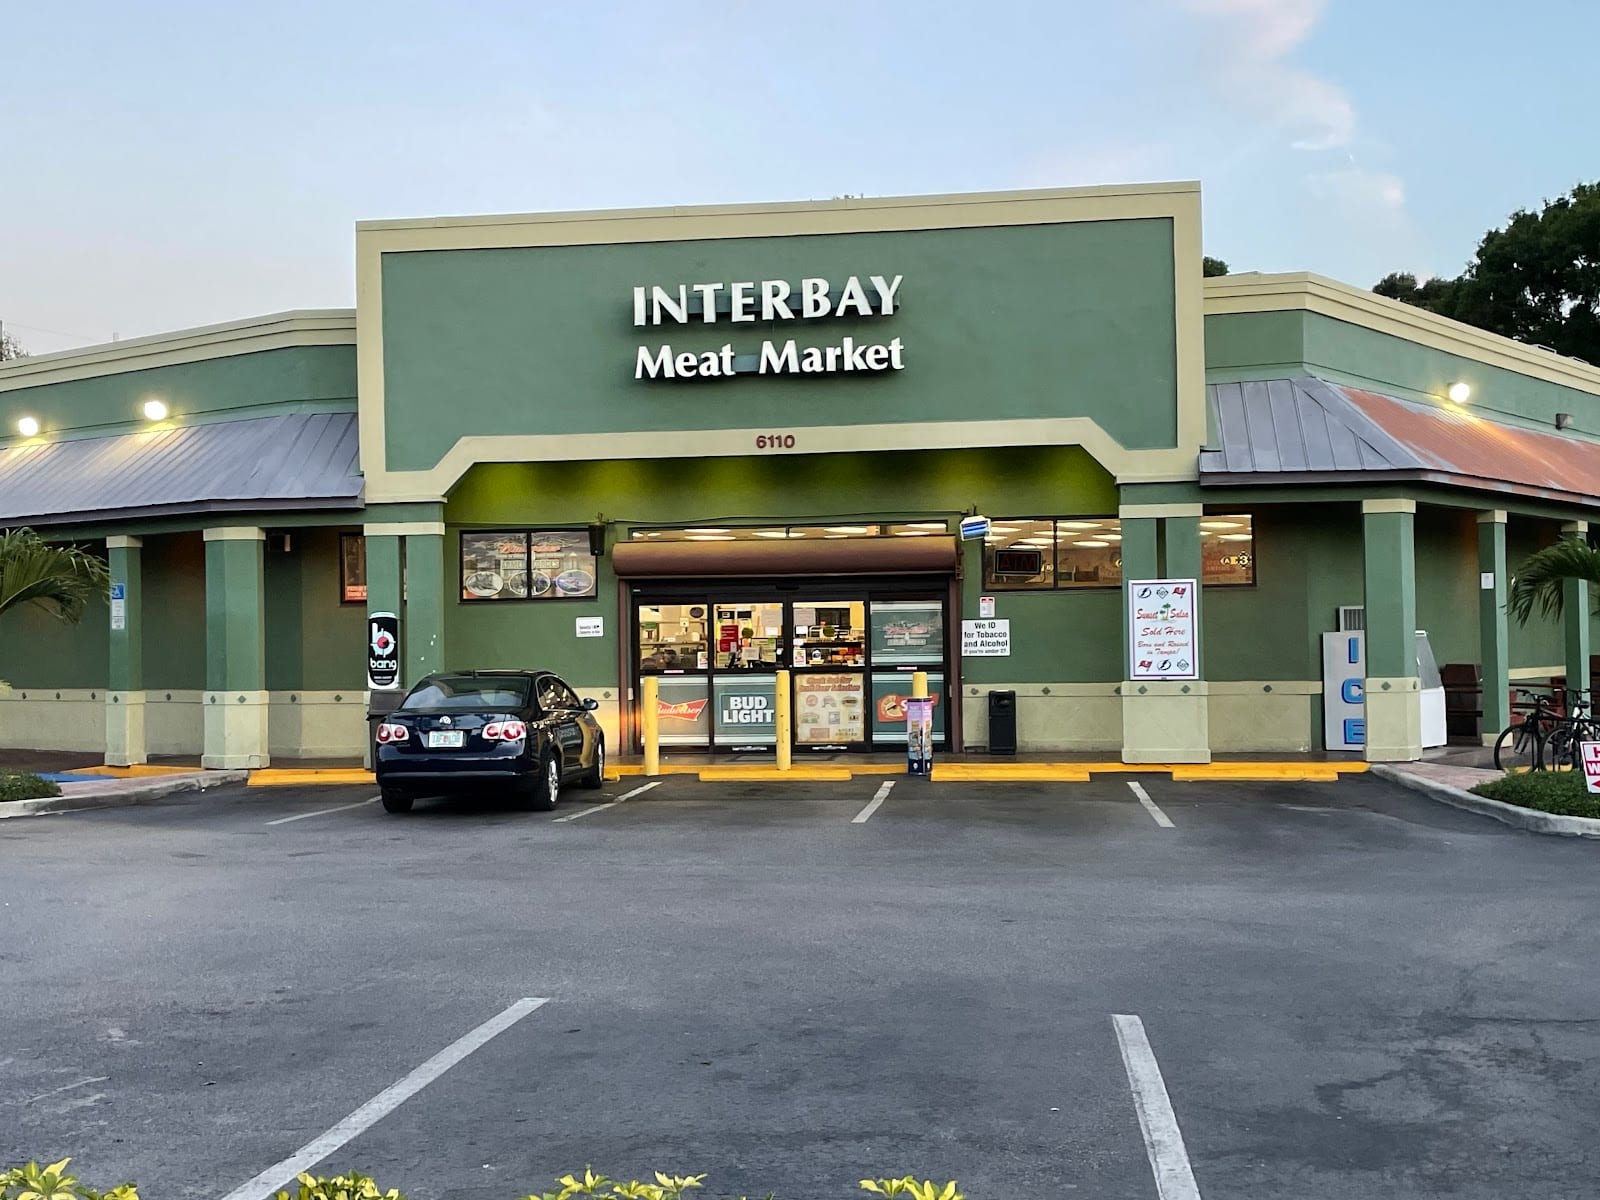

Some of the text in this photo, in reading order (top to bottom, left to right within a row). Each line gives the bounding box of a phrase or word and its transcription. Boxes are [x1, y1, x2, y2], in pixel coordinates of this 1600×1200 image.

[633, 275, 903, 326] INTERBAY
[635, 336, 904, 379] Meat Market
[756, 434, 795, 449] 6110
[1136, 608, 1189, 619] Sunset Salsa
[988, 621, 996, 629] ID
[1141, 626, 1185, 636] Sold Here
[980, 639, 1008, 647] Alcohol
[370, 657, 397, 670] bang
[1341, 637, 1365, 745] ICE
[730, 696, 767, 710] BUD
[723, 710, 775, 723] LIGHT
